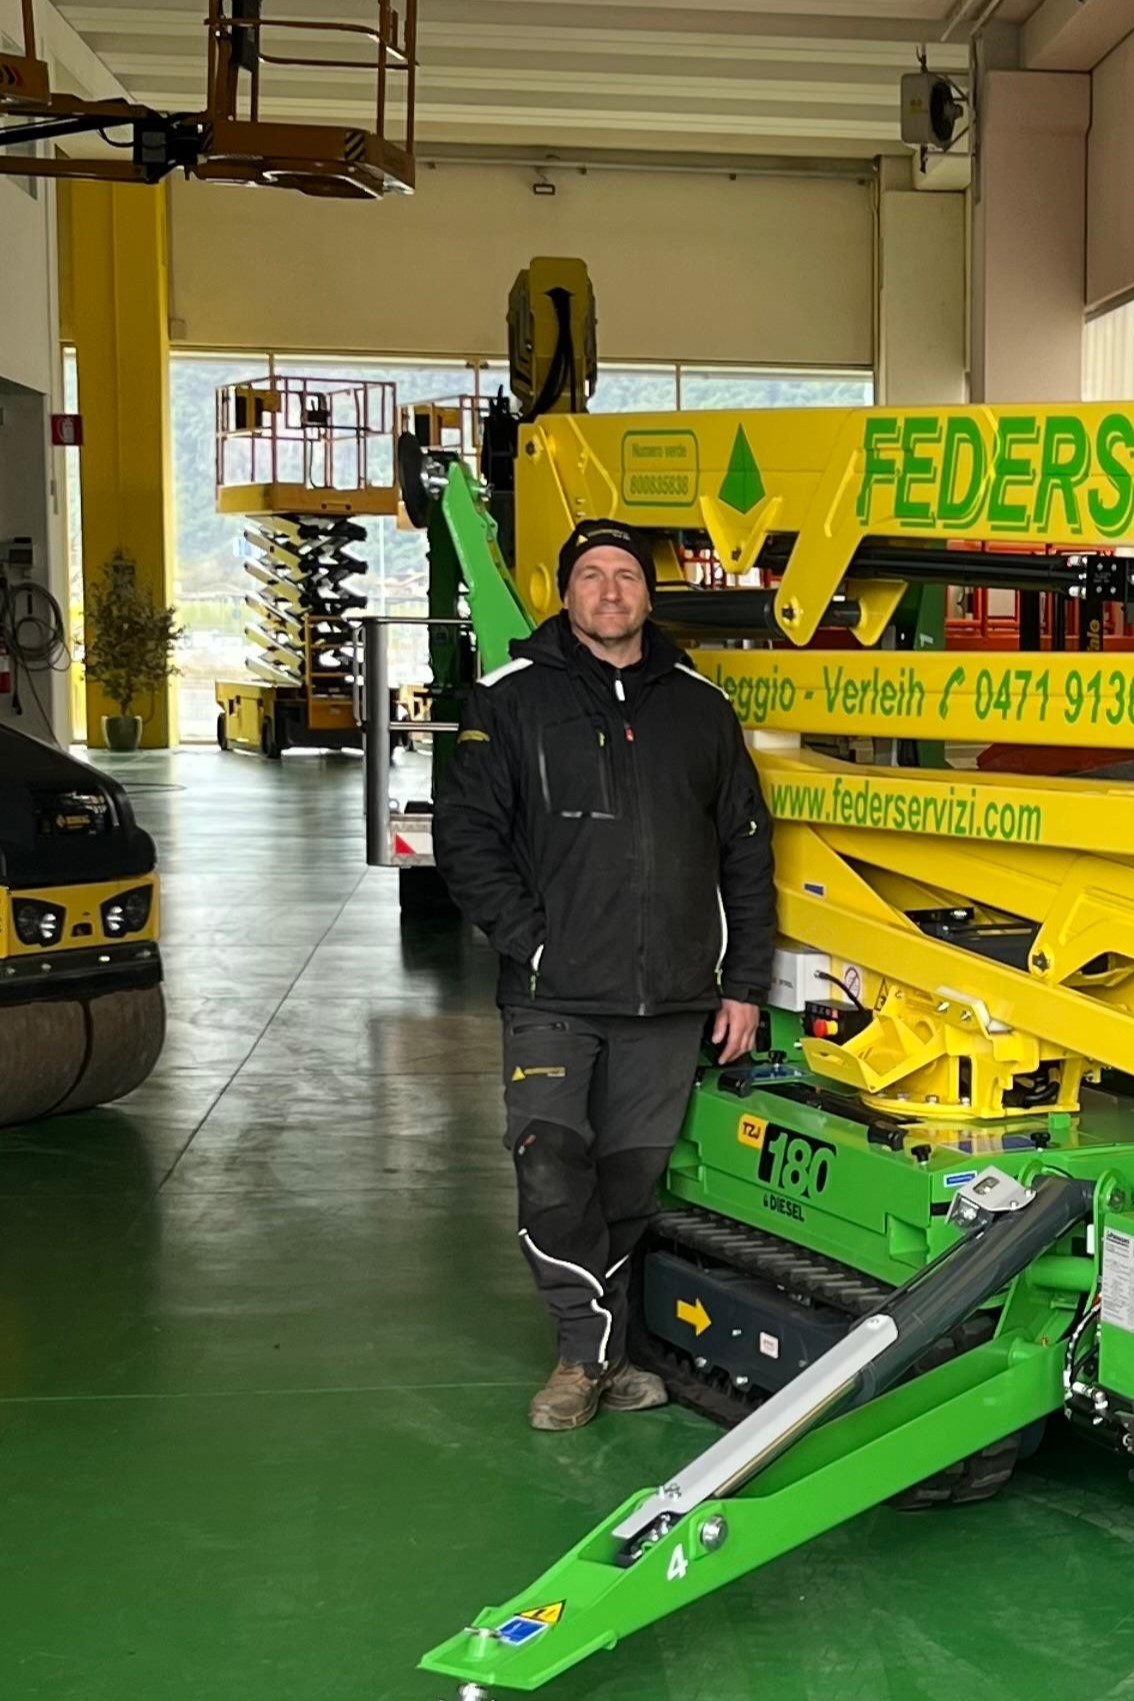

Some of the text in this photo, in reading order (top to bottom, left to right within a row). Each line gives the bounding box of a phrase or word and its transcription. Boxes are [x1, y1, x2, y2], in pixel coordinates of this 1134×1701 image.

[632, 443, 687, 457] Numero verde
[823, 666, 925, 717] Verleih
[975, 668, 1050, 721] 0471
[771, 777, 1042, 842] www.federservizi.com
[767, 1131, 836, 1198] 180
[769, 1193, 805, 1222] DIESEL
[666, 1542, 689, 1581] 4
